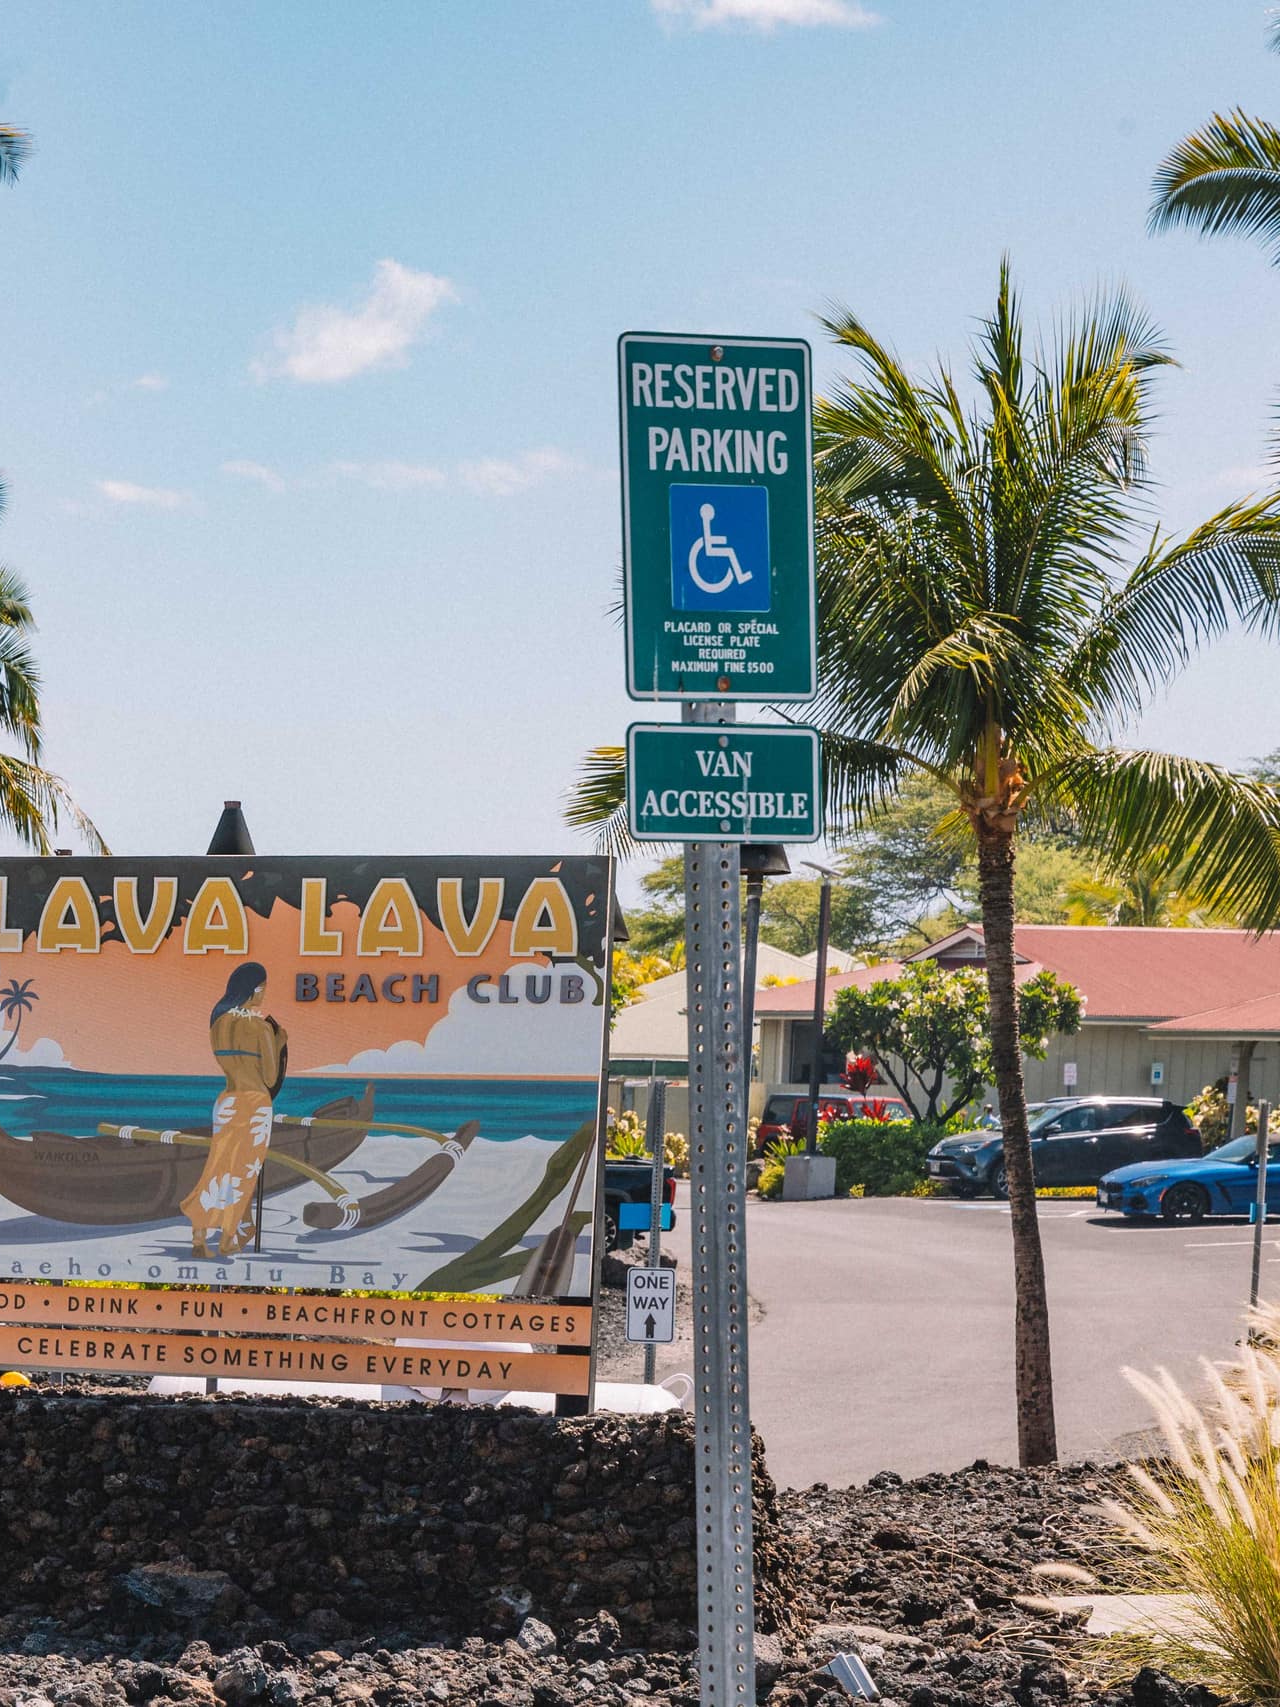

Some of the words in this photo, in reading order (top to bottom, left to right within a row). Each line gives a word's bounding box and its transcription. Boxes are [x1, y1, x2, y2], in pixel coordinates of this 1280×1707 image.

[632, 363, 799, 412] RESERVED
[648, 426, 788, 475] PARKING
[664, 621, 711, 633] PLACARD
[718, 622, 732, 633] OR
[738, 623, 779, 635] SPECIAL
[683, 635, 724, 646] LICENSE
[730, 636, 761, 647] PLATE
[671, 661, 719, 673] MAXIMUM
[724, 662, 746, 673] FINE
[698, 648, 746, 660] REQUIRED
[695, 750, 753, 778] VAN
[640, 790, 809, 819] ACCESSIBLE
[299, 877, 578, 957] LAVA
[295, 972, 440, 1003] BEACH
[466, 973, 585, 1004] CLUB
[329, 1265, 408, 1290] Bay
[634, 1275, 669, 1289] ONE
[68, 1296, 139, 1315] DRINK
[181, 1301, 223, 1318] FUN
[267, 1305, 429, 1327] BEACHFRONT
[443, 1311, 576, 1333] COTTAGES
[633, 1296, 669, 1310] WAY
[17, 1337, 167, 1362] CELEBRATE
[183, 1346, 348, 1371] SOMETHING
[367, 1355, 513, 1379] EVERYDAY
